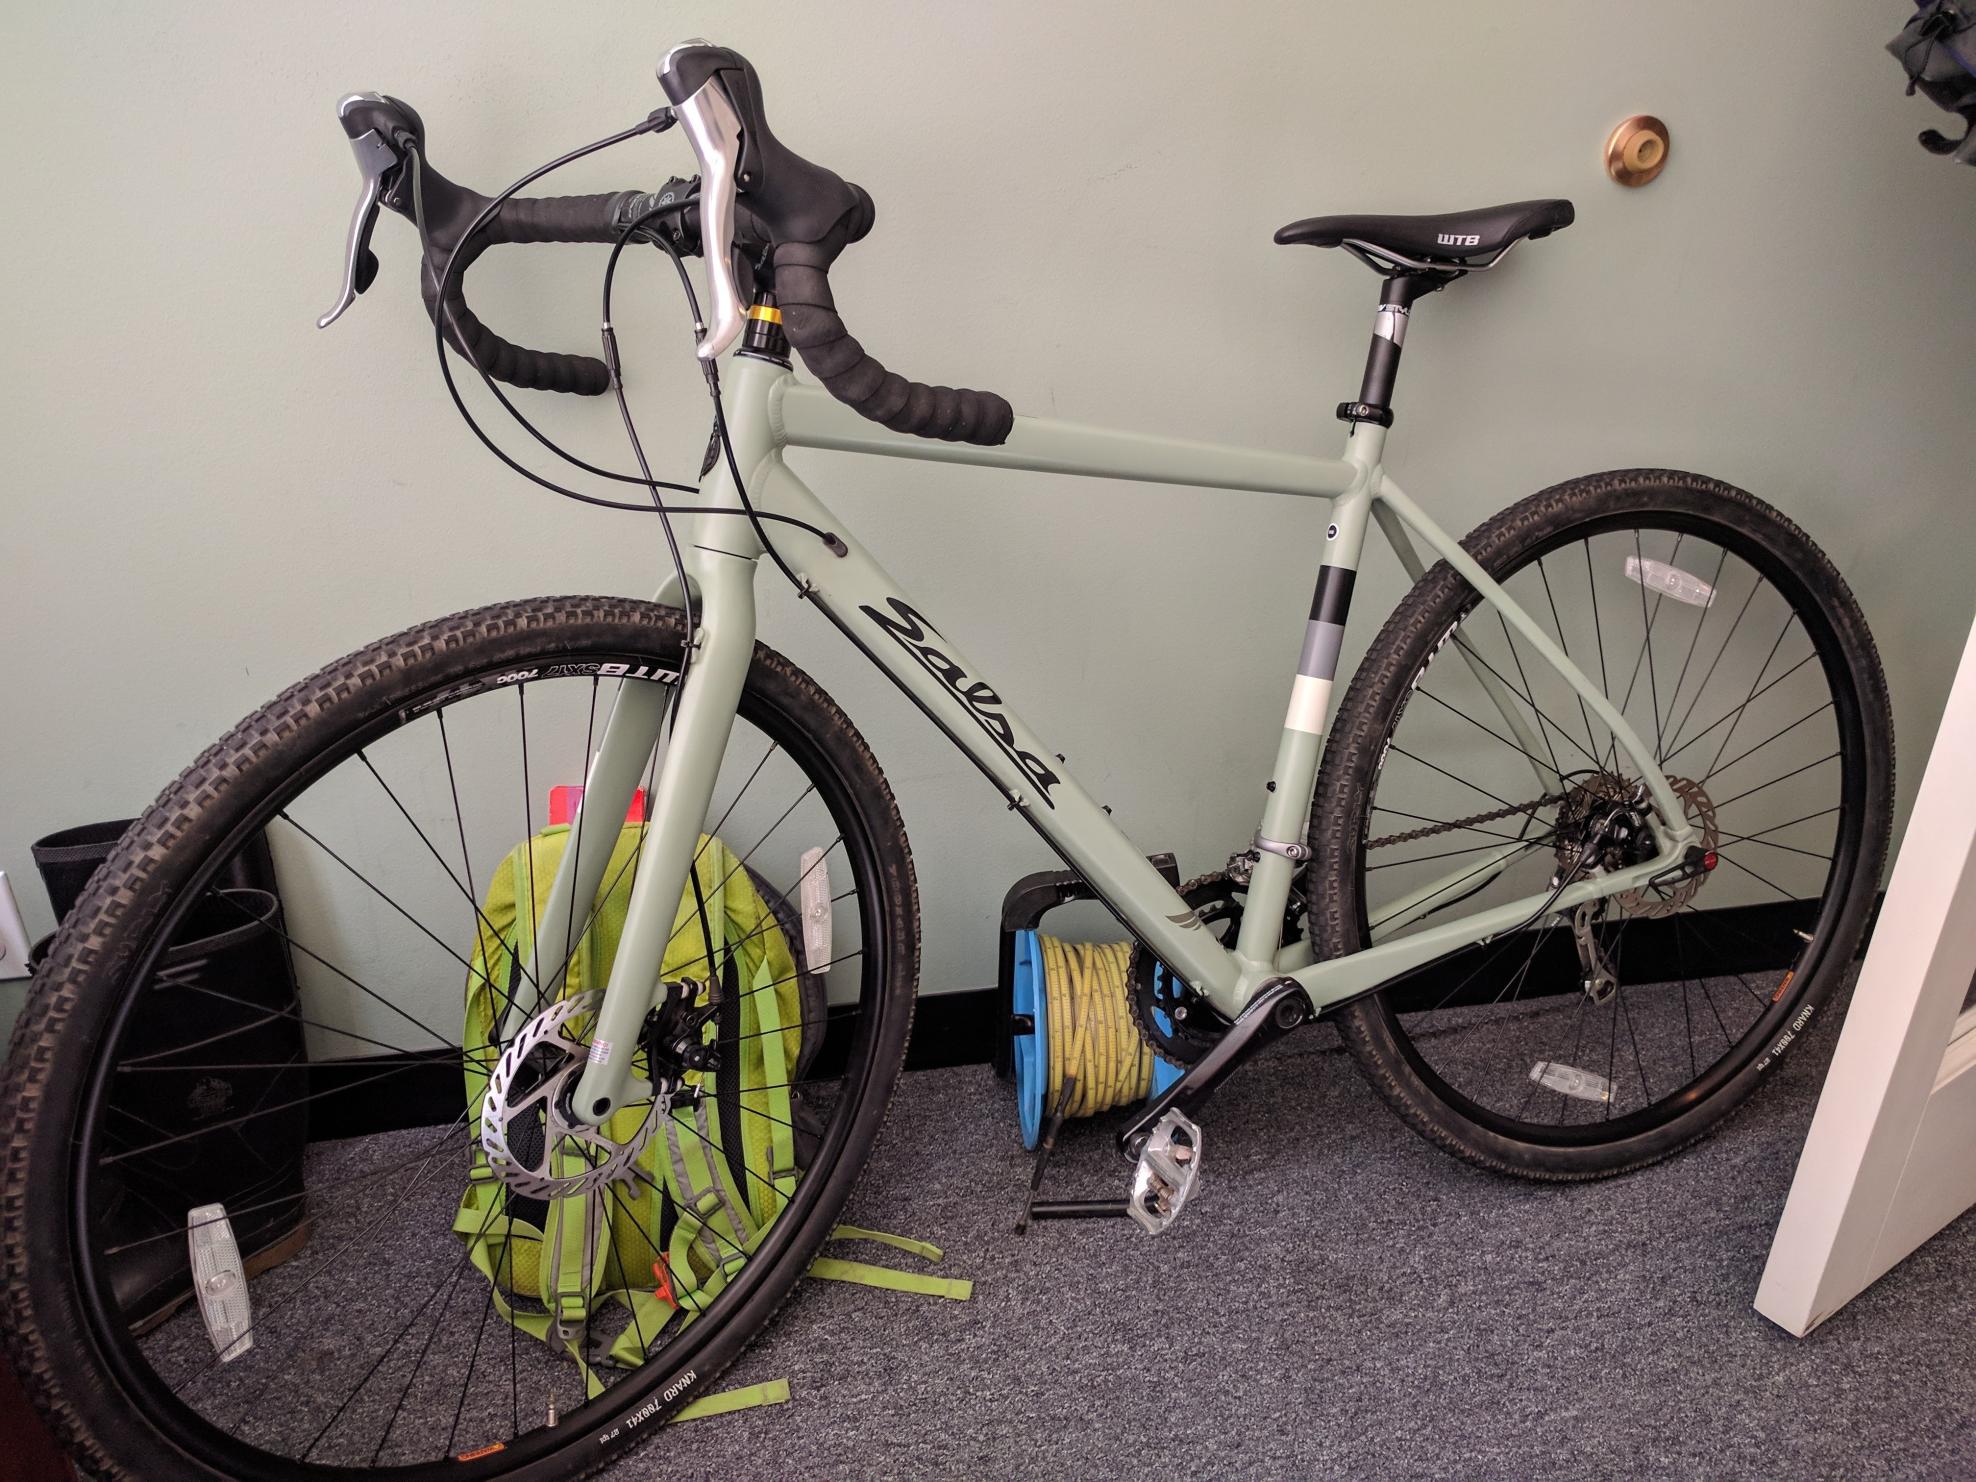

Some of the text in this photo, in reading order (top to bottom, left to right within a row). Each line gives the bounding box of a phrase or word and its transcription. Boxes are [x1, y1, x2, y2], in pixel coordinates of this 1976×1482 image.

[1437, 233, 1480, 246] WTB
[858, 596, 1061, 810] Salsa
[1793, 1004, 1815, 1031] KNARD
[663, 1369, 697, 1402] KNARD
[626, 1397, 662, 1429] 700X41
